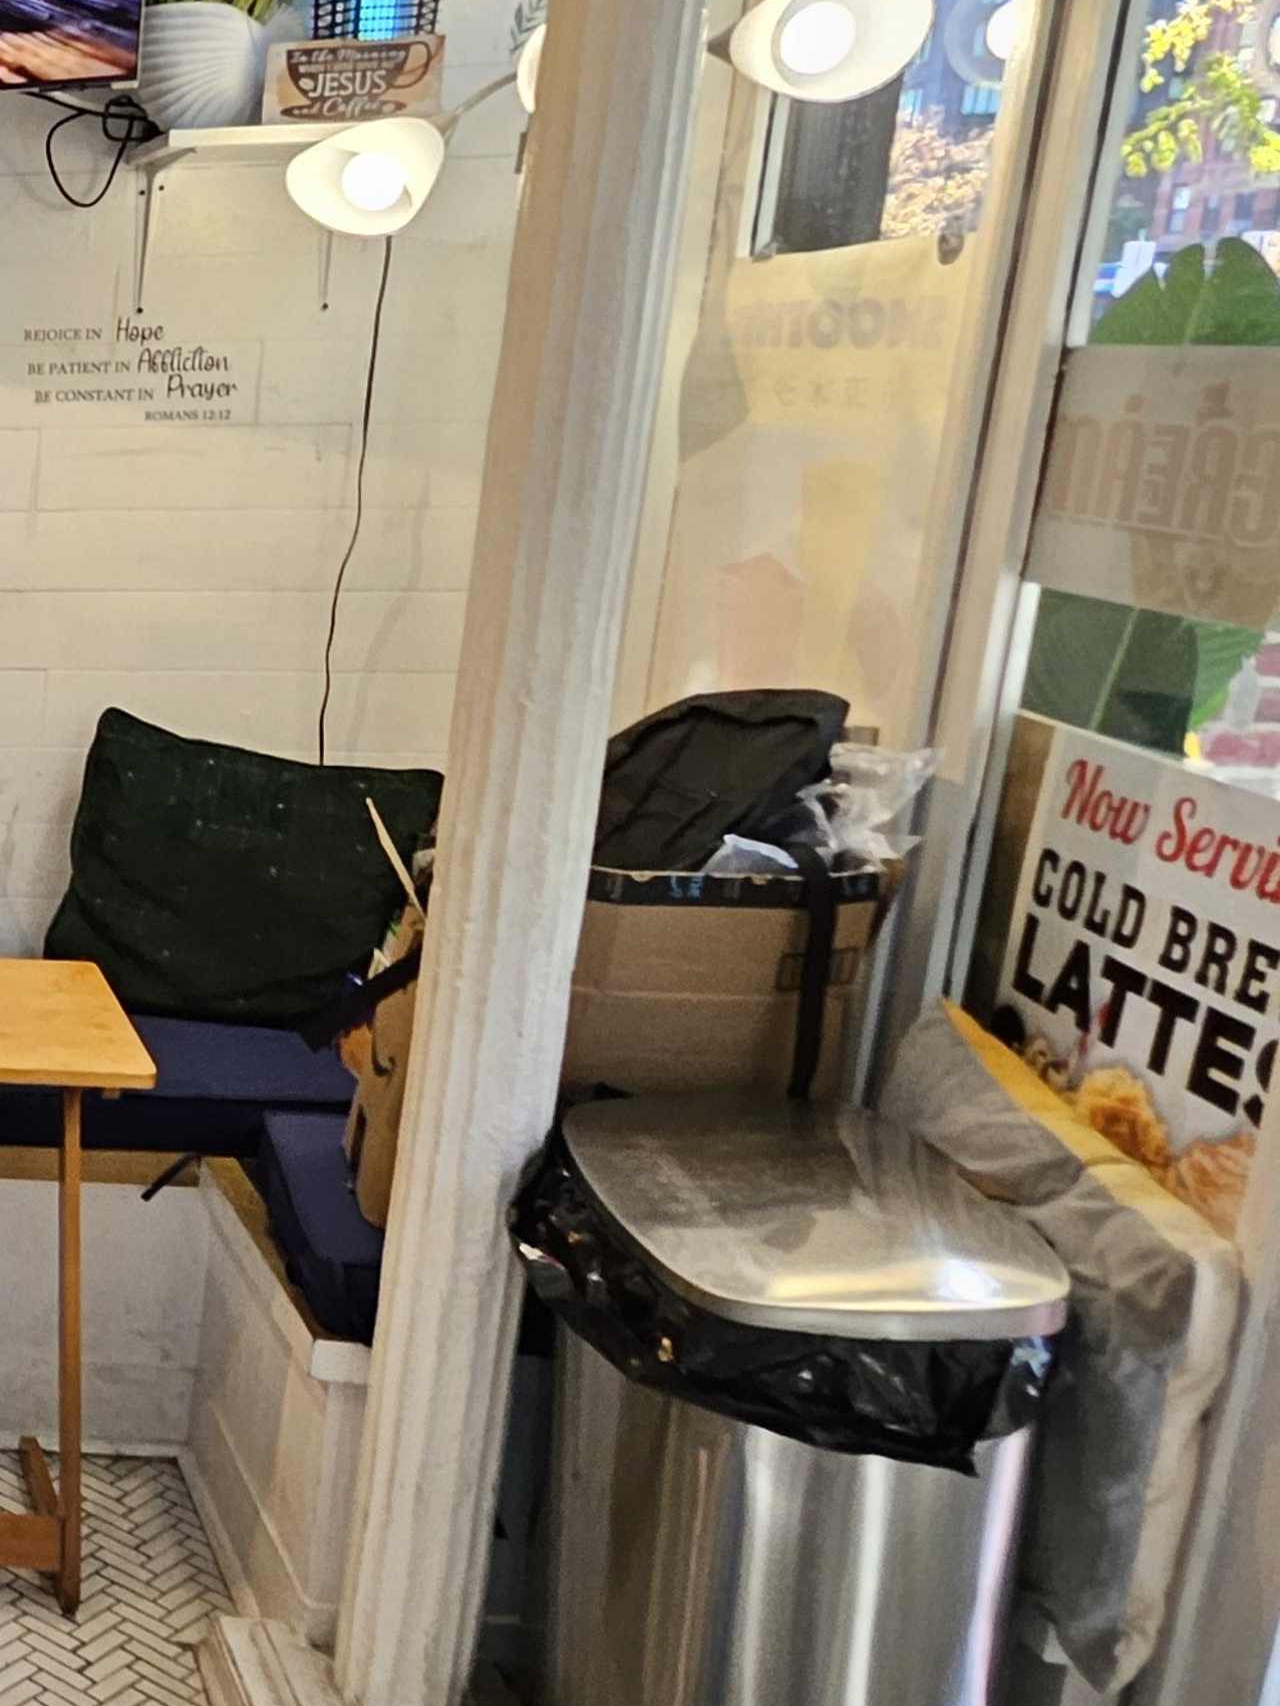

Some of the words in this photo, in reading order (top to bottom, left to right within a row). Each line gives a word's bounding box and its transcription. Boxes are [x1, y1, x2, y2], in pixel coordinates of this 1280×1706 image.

[308, 70, 387, 98] JESUS
[23, 328, 82, 342] REJOICE
[85, 328, 102, 340] IN
[116, 316, 165, 345] Hope
[27, 363, 45, 376] BE
[48, 361, 112, 376] PATIENT
[115, 360, 131, 373] IN
[137, 345, 229, 374] Affliction
[34, 390, 52, 404] BE
[55, 388, 133, 403] CONSTANT
[137, 388, 155, 401] IN
[167, 373, 239, 401] Prayer
[144, 410, 199, 422] ROMANS
[202, 409, 232, 421] 12:12
[1060, 758, 1152, 845] Now
[1154, 796, 1280, 905] Servi
[1031, 848, 1146, 949] COLD
[1158, 905, 1280, 1015] BRE
